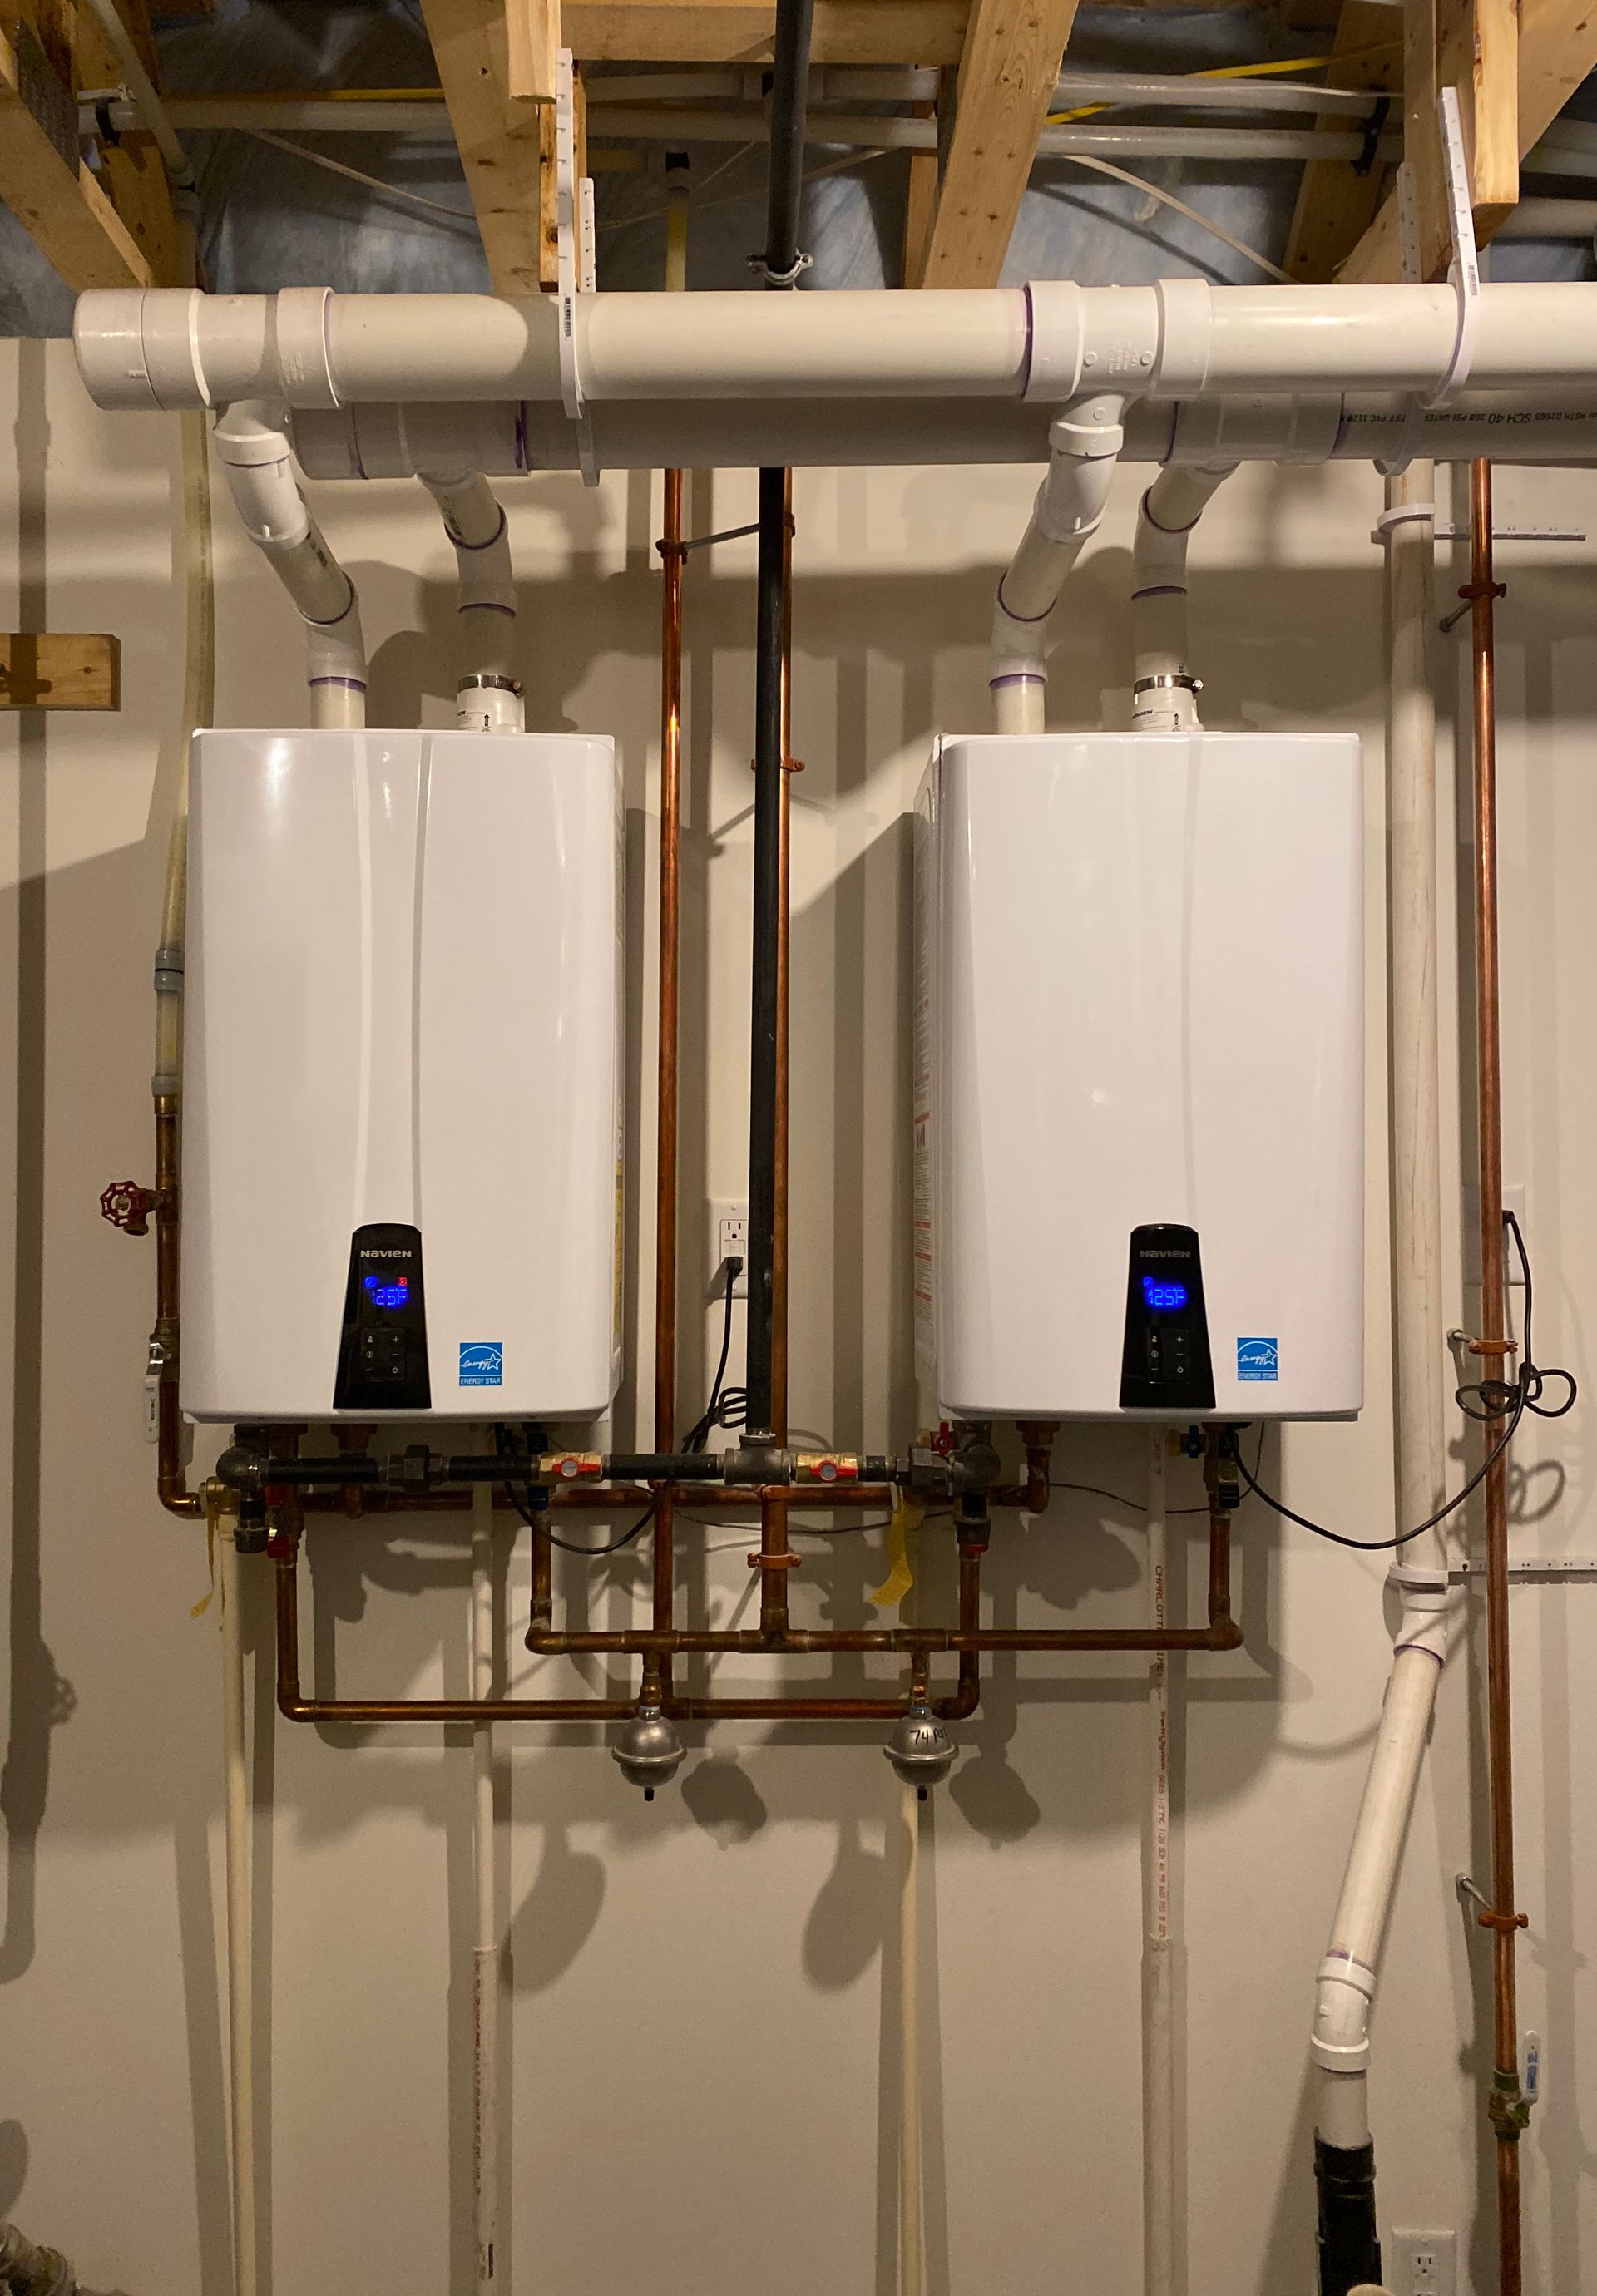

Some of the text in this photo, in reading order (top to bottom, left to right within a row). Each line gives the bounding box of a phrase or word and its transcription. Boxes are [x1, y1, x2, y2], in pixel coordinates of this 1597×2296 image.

[1487, 413, 1505, 424] 40
[1506, 412, 1532, 423] SCH
[1155, 1565, 1164, 1631] CHARLOTT
[909, 1729, 929, 1746] 74
